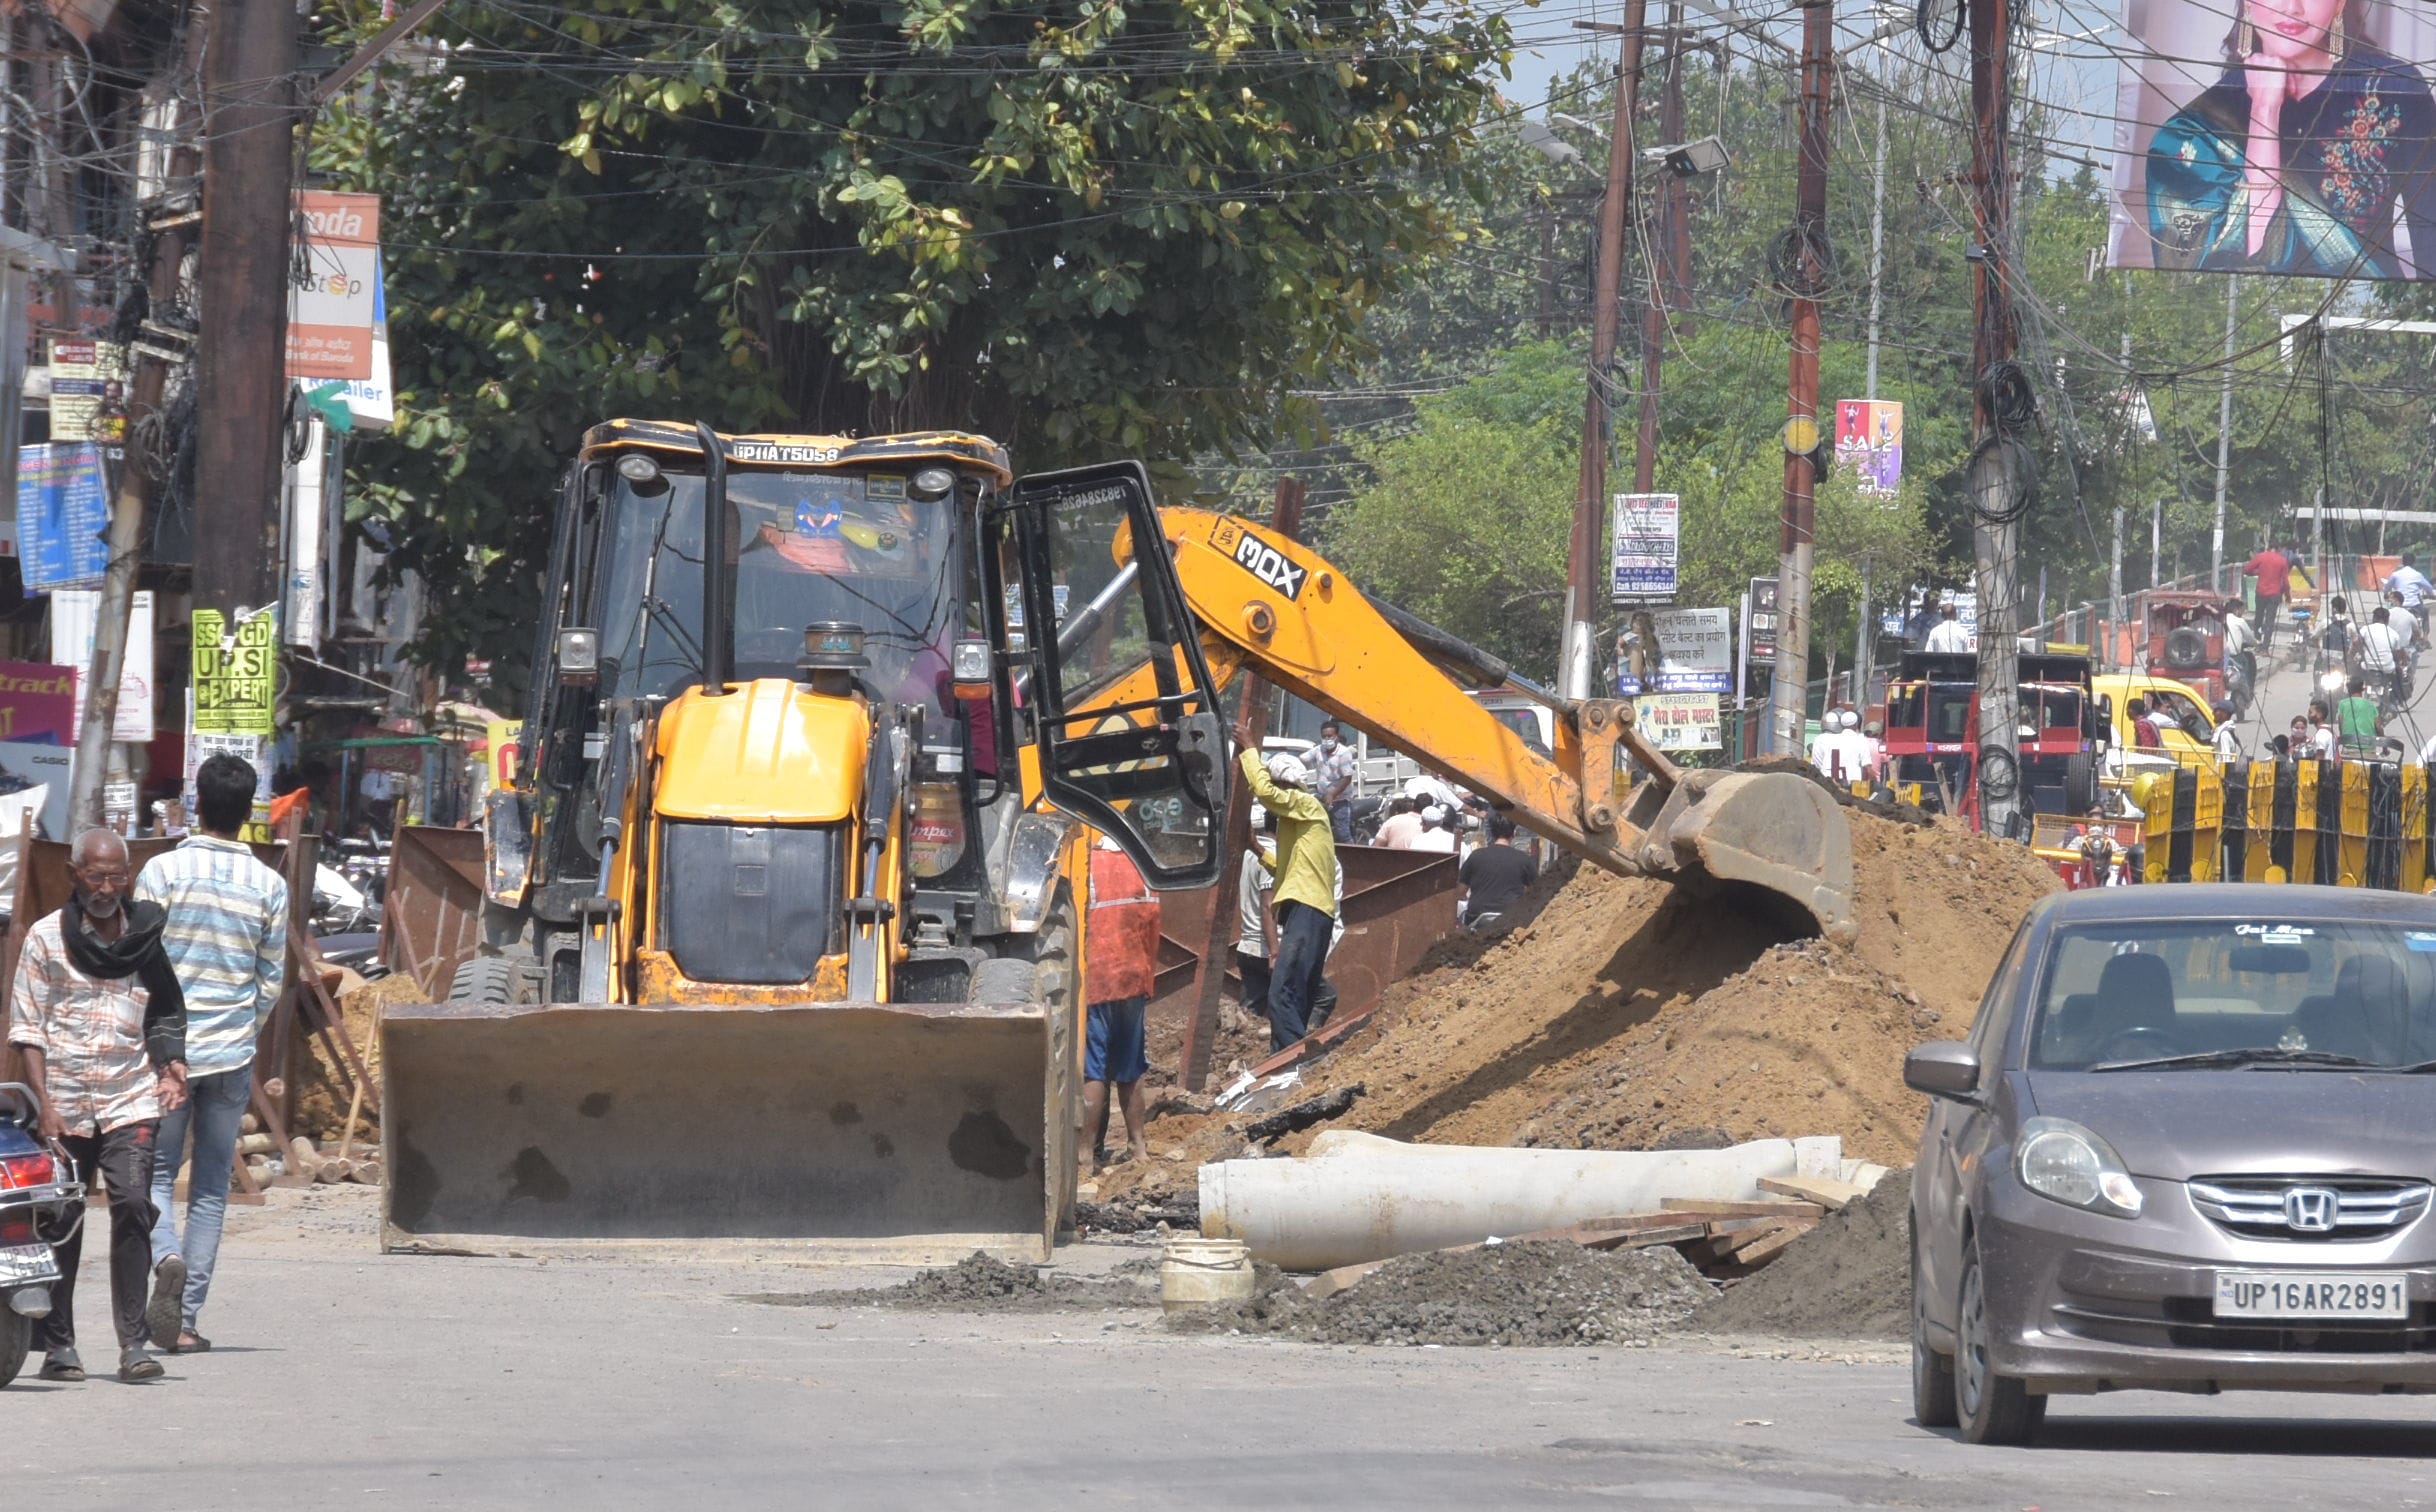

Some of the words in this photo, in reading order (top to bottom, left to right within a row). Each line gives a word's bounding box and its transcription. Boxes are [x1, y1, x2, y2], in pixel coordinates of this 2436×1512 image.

[1843, 431, 1893, 452] SALE
[32, 756, 69, 765] CASIO
[2234, 1282, 2401, 1310] UP16AR2891
